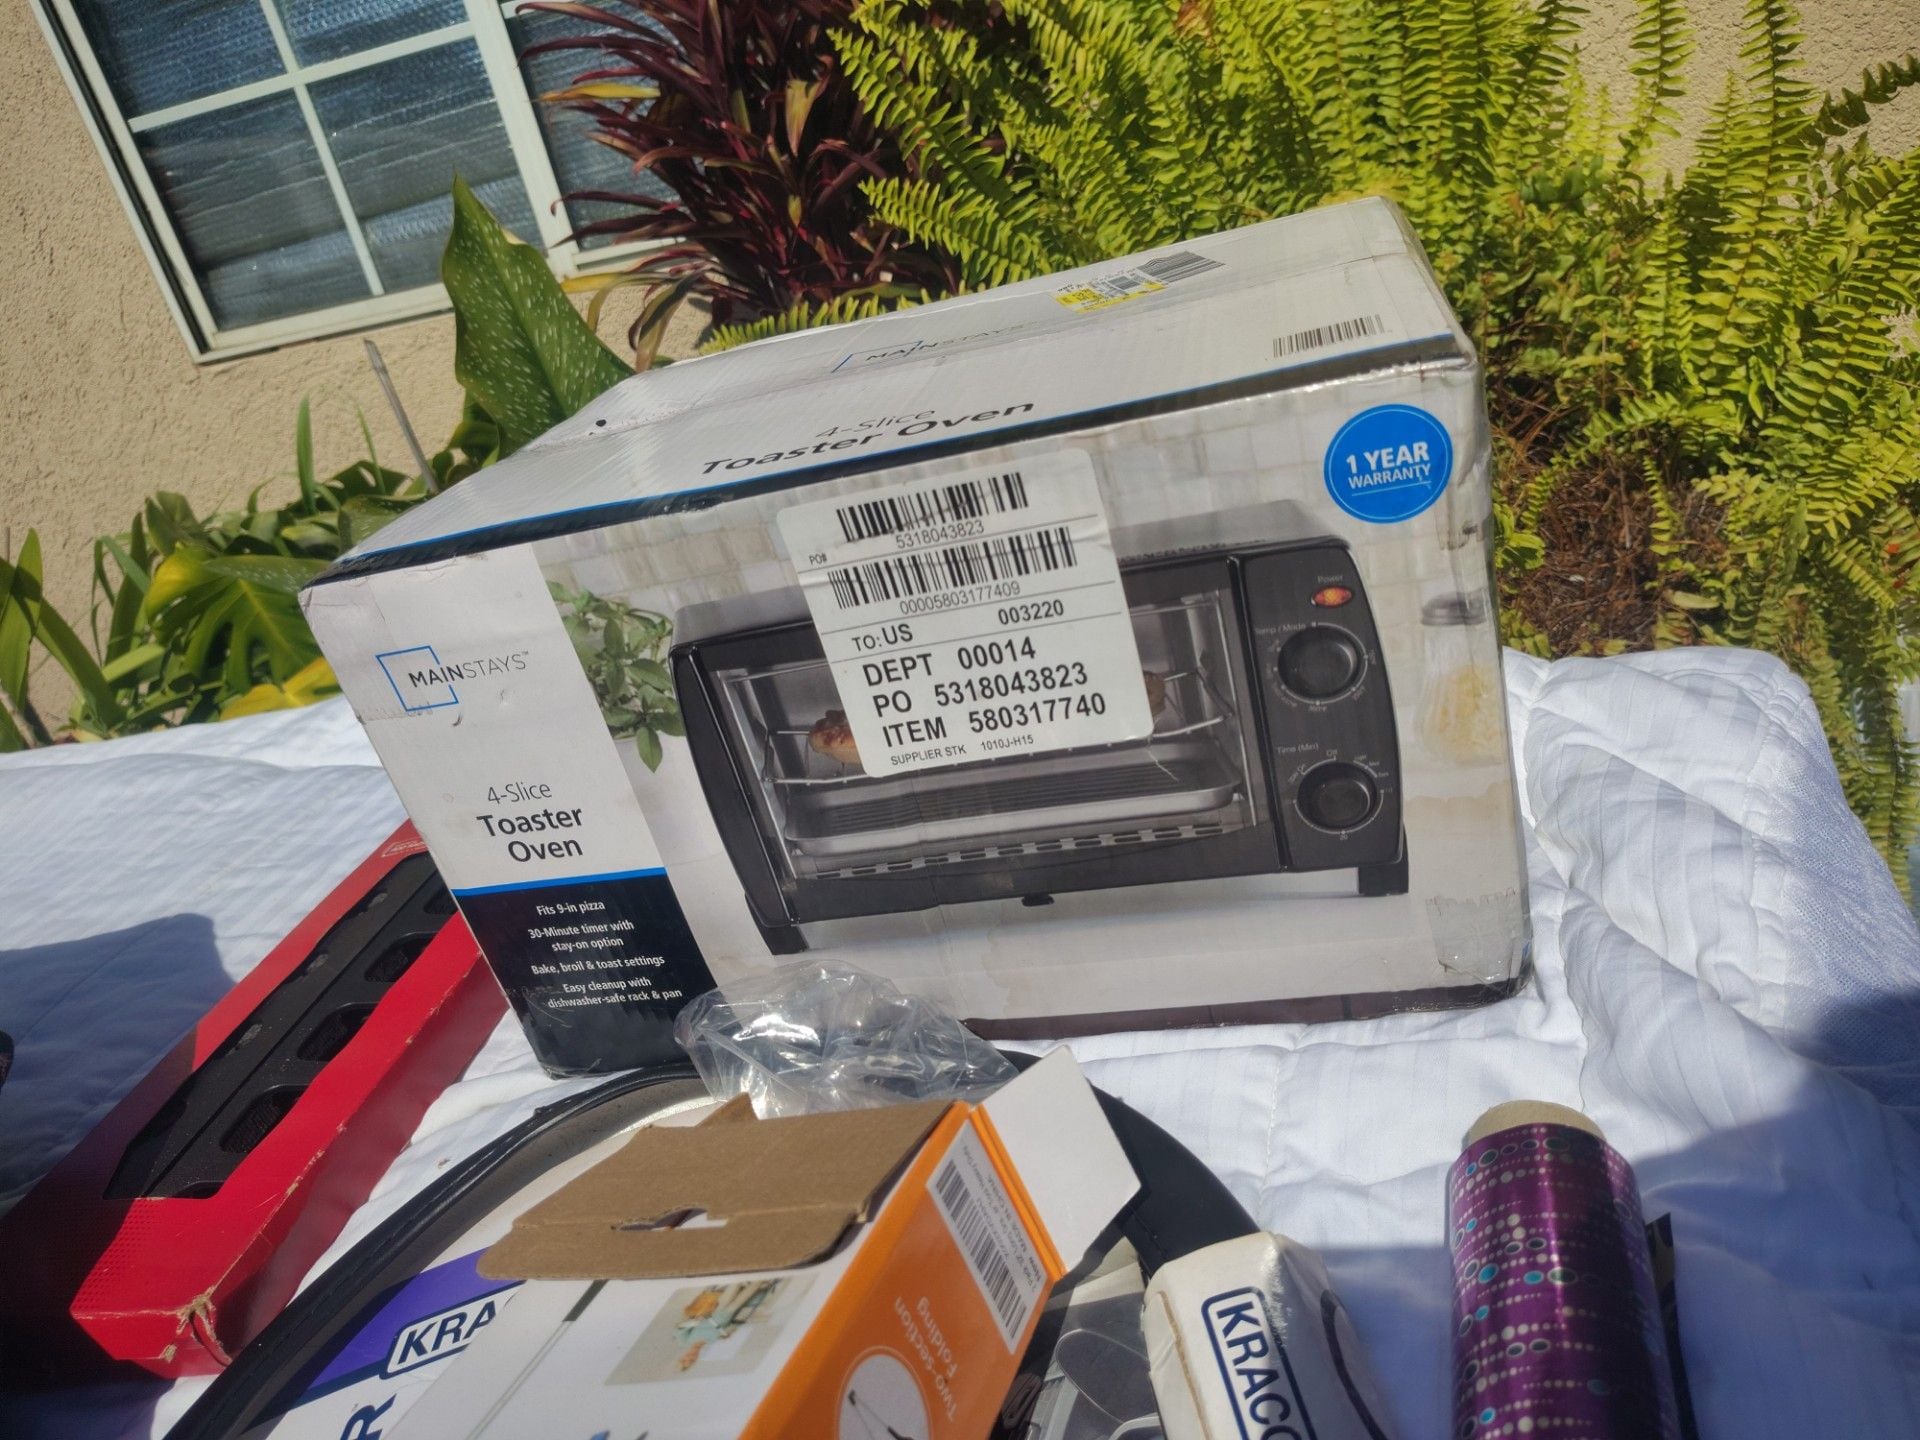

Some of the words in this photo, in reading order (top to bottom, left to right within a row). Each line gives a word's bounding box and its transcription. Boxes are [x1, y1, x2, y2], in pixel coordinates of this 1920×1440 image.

[815, 409, 935, 438] 4-Slice
[702, 432, 885, 474] Toaster
[897, 402, 1034, 436] Oven
[1346, 454, 1358, 474] 1
[1364, 441, 1430, 471] YEAR
[1347, 463, 1431, 490] WARRANTY
[895, 519, 985, 549] 5318043823
[900, 580, 1021, 615] 00005803177409
[998, 599, 1064, 626] 003220
[862, 653, 933, 687] DEPT
[957, 636, 1036, 670] 00014
[872, 690, 912, 717] PO
[934, 662, 1089, 707] 5318043823
[882, 716, 947, 748] ITEM
[969, 692, 1106, 734] 580317740
[890, 749, 943, 767] SUPPLIER
[944, 744, 967, 758] STK
[980, 735, 1034, 752] 1010J-H15
[487, 781, 553, 805] 4-Slice
[476, 808, 583, 837] Toaster
[508, 838, 583, 863] Oven
[536, 903, 556, 916] Fits
[557, 903, 577, 914] 9-in
[579, 901, 606, 914] pizza
[528, 926, 580, 939] 30-Minute
[581, 923, 609, 934] timer
[609, 919, 635, 931] with
[551, 940, 589, 952] stay-on
[591, 936, 624, 949] option
[531, 963, 560, 976] Bake,
[560, 961, 585, 973] broil
[586, 960, 595, 971] &
[596, 958, 622, 969] toast
[624, 955, 665, 968] settings
[547, 991, 626, 1009] dishwasher-safe
[628, 990, 650, 1001] rack
[652, 990, 661, 1000] &
[662, 989, 683, 1000] pan
[562, 983, 587, 994] Easy
[588, 979, 627, 992] cleanup
[627, 977, 652, 988] with
